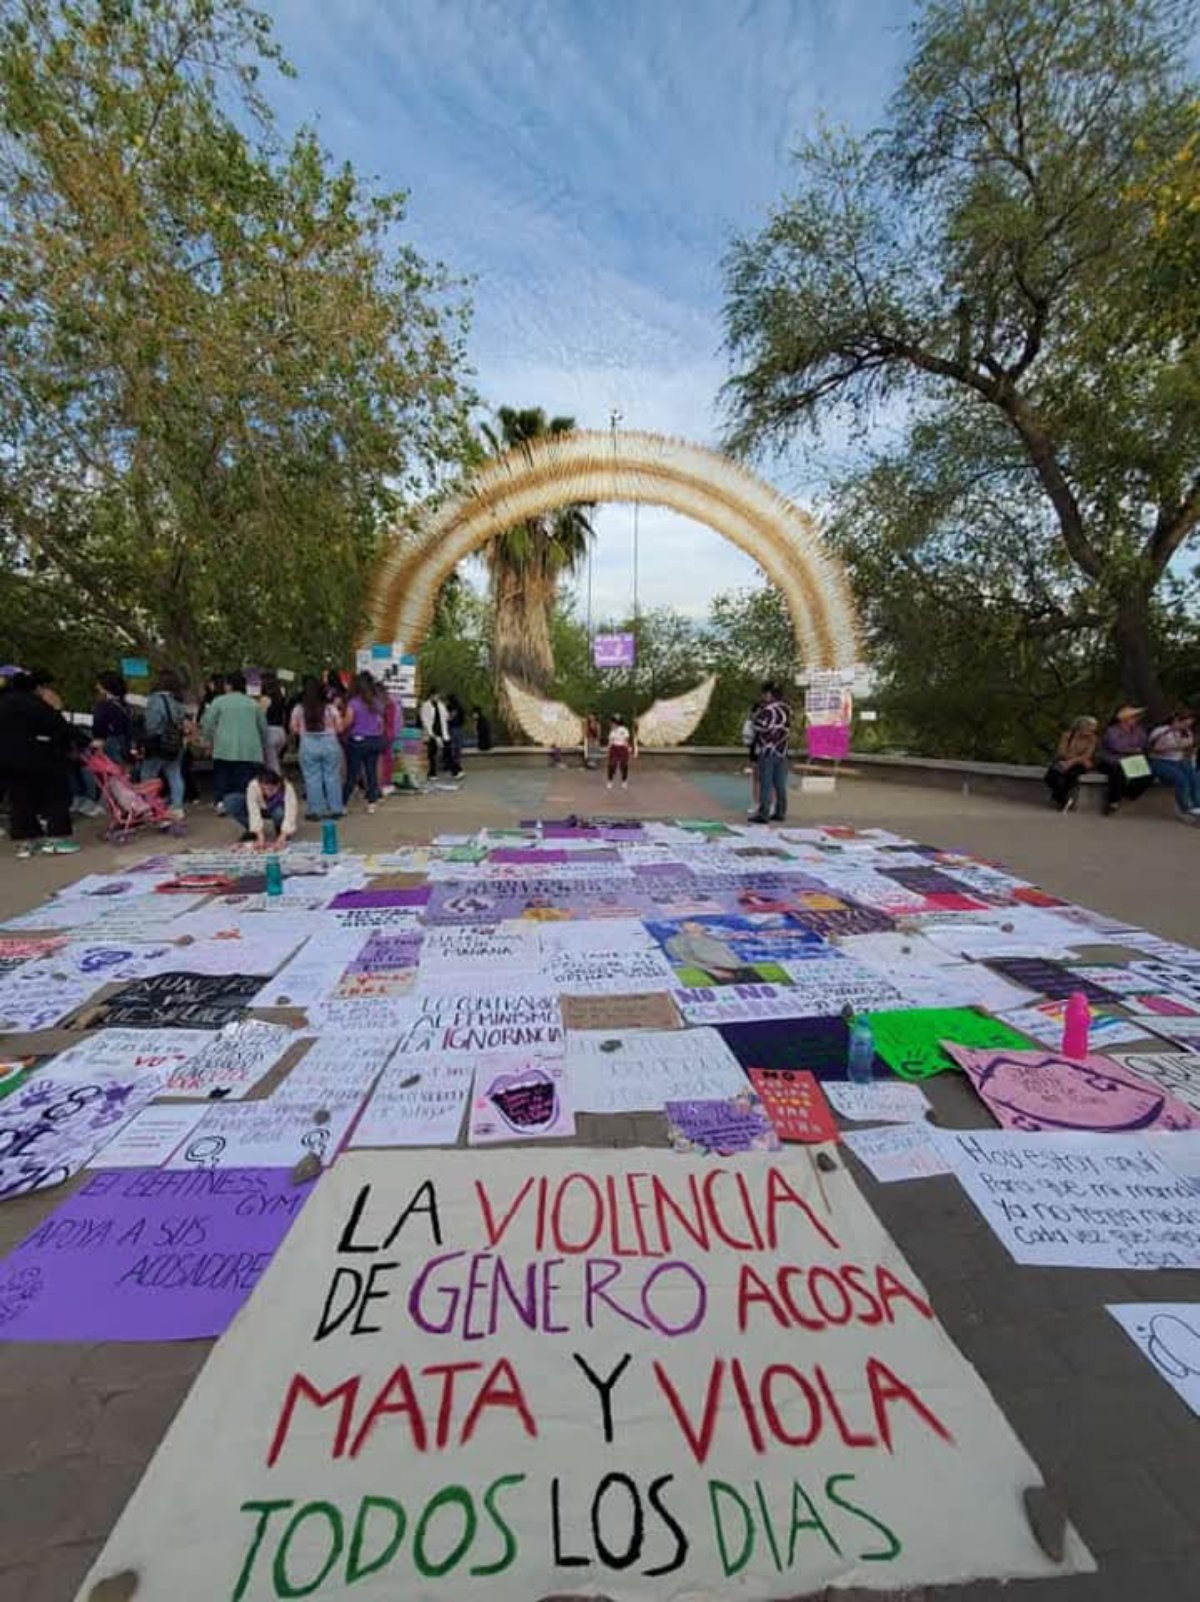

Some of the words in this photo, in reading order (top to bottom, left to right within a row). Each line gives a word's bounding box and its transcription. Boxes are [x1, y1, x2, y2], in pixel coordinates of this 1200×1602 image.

[442, 1026, 562, 1051] IGNORANCIA
[956, 1134, 1023, 1169] Hoy
[236, 1193, 302, 1216] GYM
[337, 1179, 443, 1254] LA
[474, 1166, 841, 1258] VIOLENCIA
[1032, 1203, 1071, 1222] no
[116, 1217, 146, 1246] A
[114, 1252, 273, 1289] ACOSADORE
[312, 1261, 402, 1342] DE
[737, 1262, 935, 1335] ACOSA
[266, 1356, 540, 1469] MATA
[572, 1352, 632, 1443] Y
[652, 1355, 957, 1468] VIOLA
[231, 1472, 527, 1602] TODOS
[551, 1471, 690, 1577] LOS
[708, 1473, 903, 1578] DIAS
